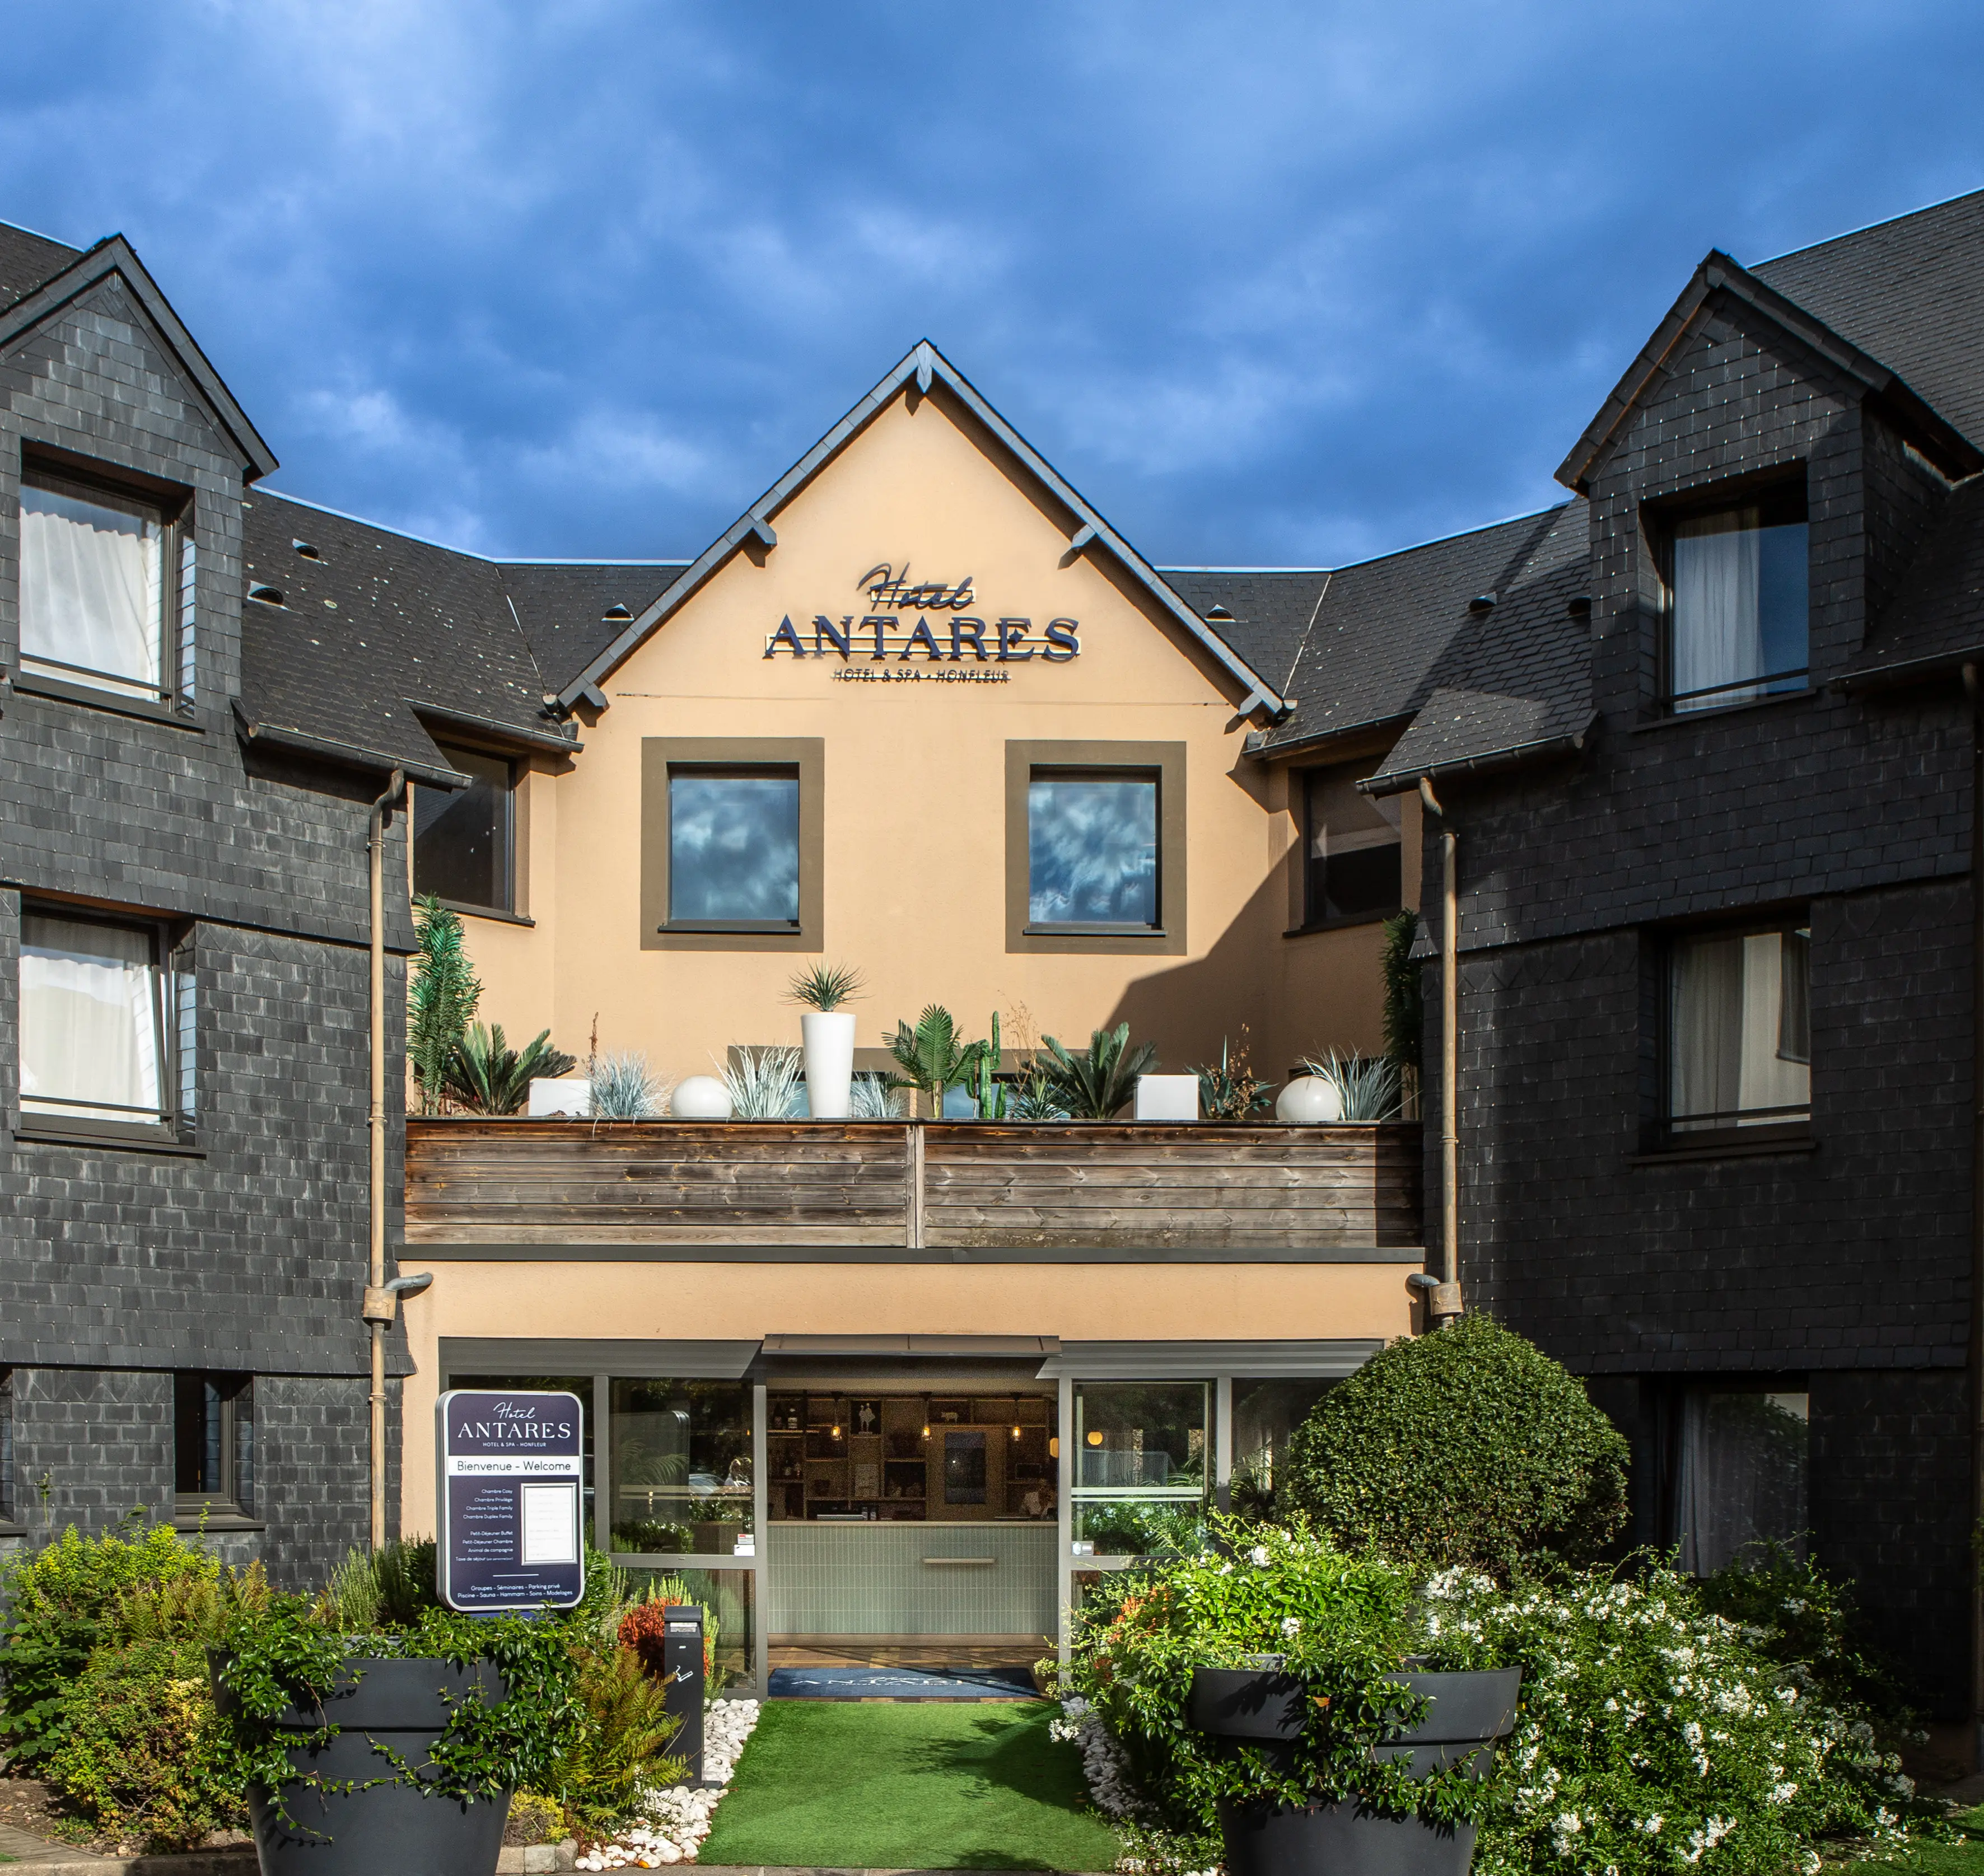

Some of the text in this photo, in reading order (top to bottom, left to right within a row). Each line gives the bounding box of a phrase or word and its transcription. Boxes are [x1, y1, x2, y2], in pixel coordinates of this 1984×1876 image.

[857, 562, 973, 611] Hotel
[764, 614, 1080, 661] ANTARES
[834, 669, 876, 681] HOTEL
[882, 669, 891, 681] &
[897, 669, 920, 682] SPA
[936, 670, 1009, 683] HONFLEUR
[493, 1402, 536, 1419] Hotel
[458, 1423, 571, 1439] ANTARES
[458, 1461, 512, 1471] Bienvenue
[523, 1460, 571, 1471] Welcome
